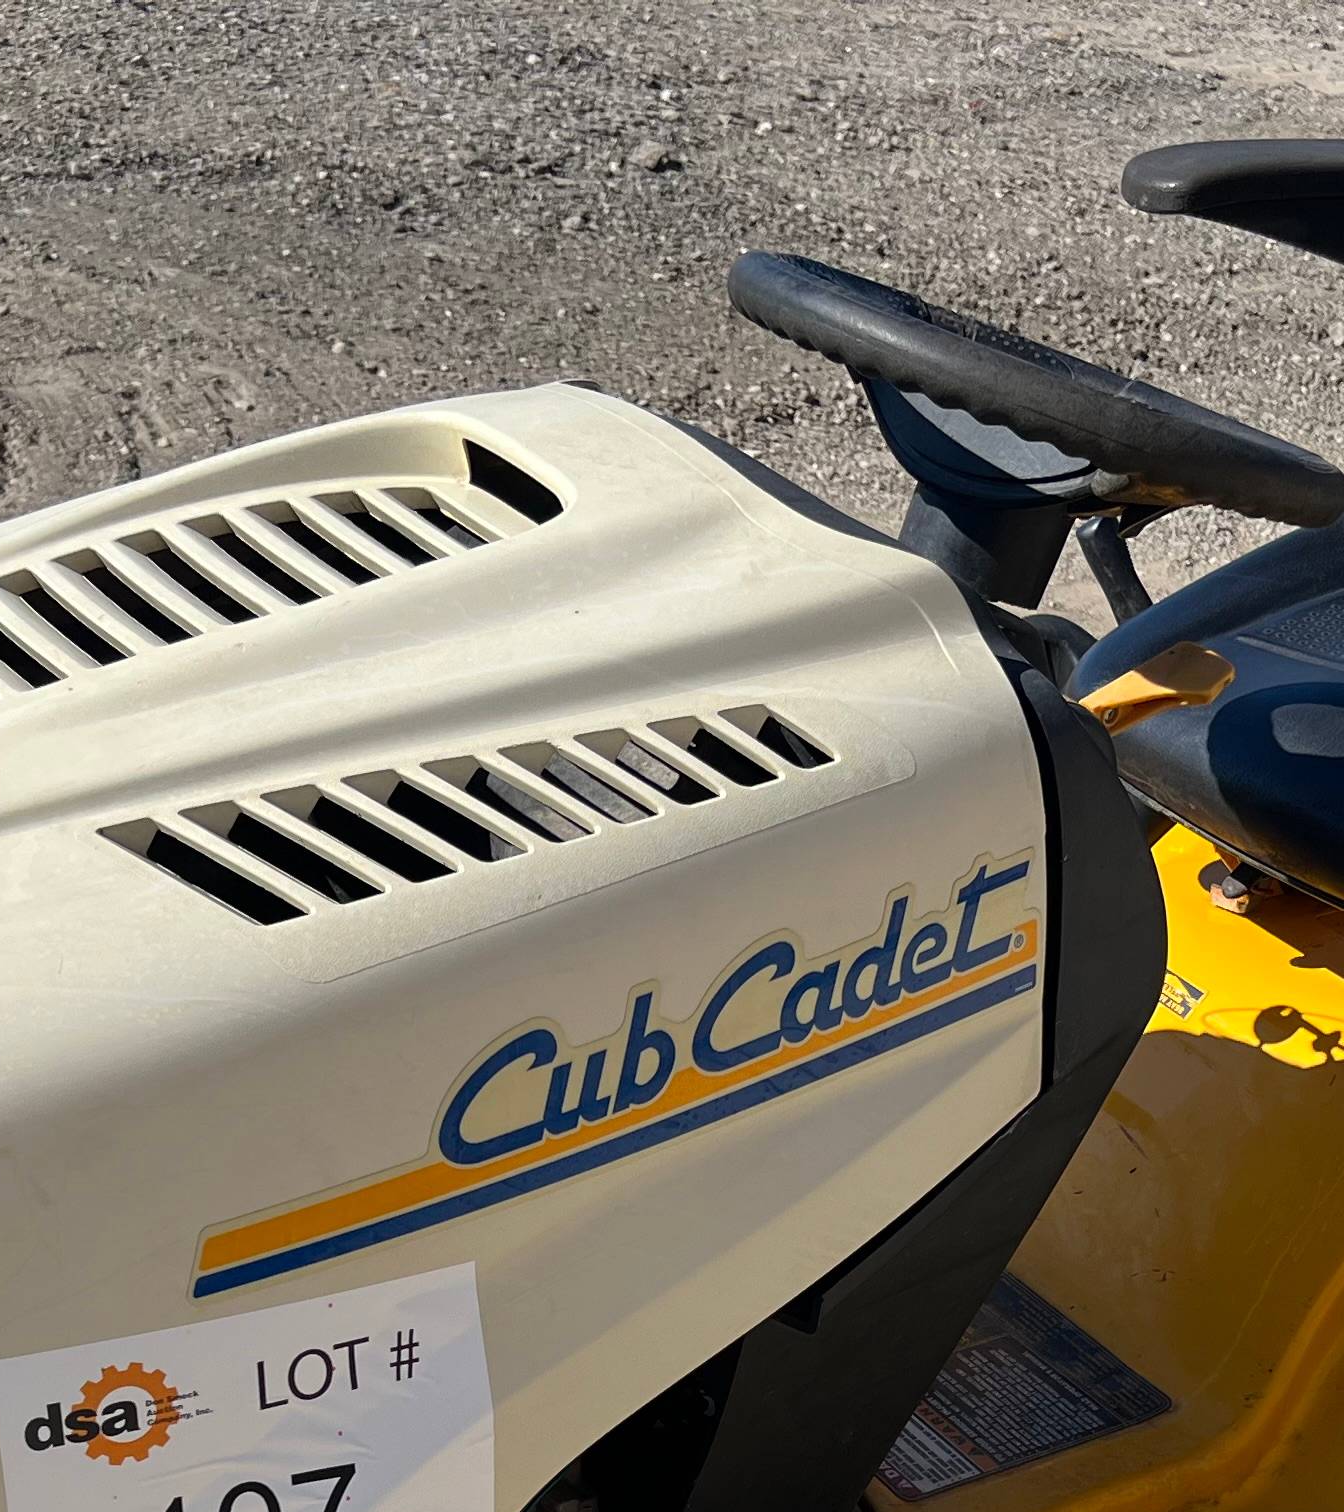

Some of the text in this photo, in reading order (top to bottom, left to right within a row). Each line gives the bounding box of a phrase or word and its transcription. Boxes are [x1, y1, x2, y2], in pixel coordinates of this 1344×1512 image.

[439, 859, 1031, 1165] Cub Cadet
[257, 1328, 420, 1411] LOT #
[24, 1400, 140, 1452] dsa
